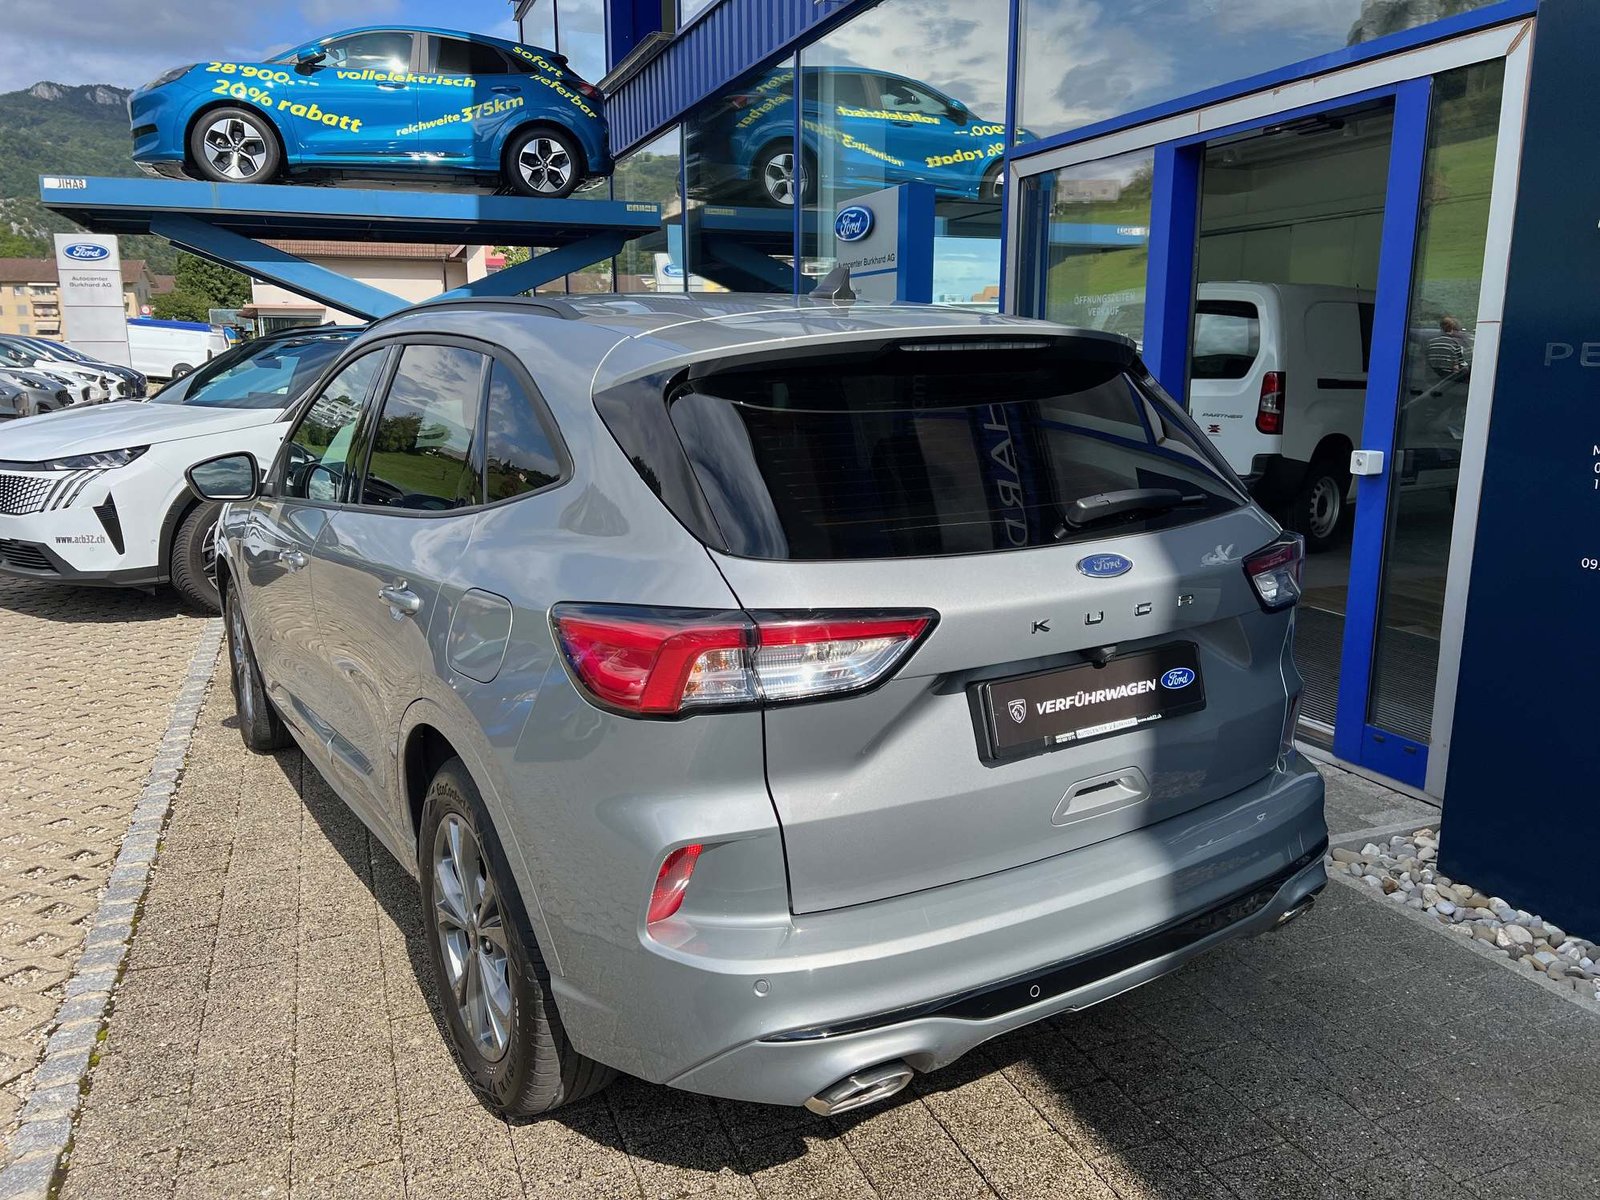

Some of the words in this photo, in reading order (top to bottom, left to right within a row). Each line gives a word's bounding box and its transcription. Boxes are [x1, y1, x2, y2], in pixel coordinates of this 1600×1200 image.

[336, 70, 477, 88] vollelektrisch
[512, 46, 564, 77] sofort
[212, 79, 273, 107] 20%
[277, 99, 363, 133] rabatt
[529, 74, 597, 118] lieferbar
[395, 113, 461, 136] reichweite
[461, 96, 524, 123] 375km
[887, 253, 896, 263] AG
[1036, 678, 1157, 716] VERFÜHRWAGEN
